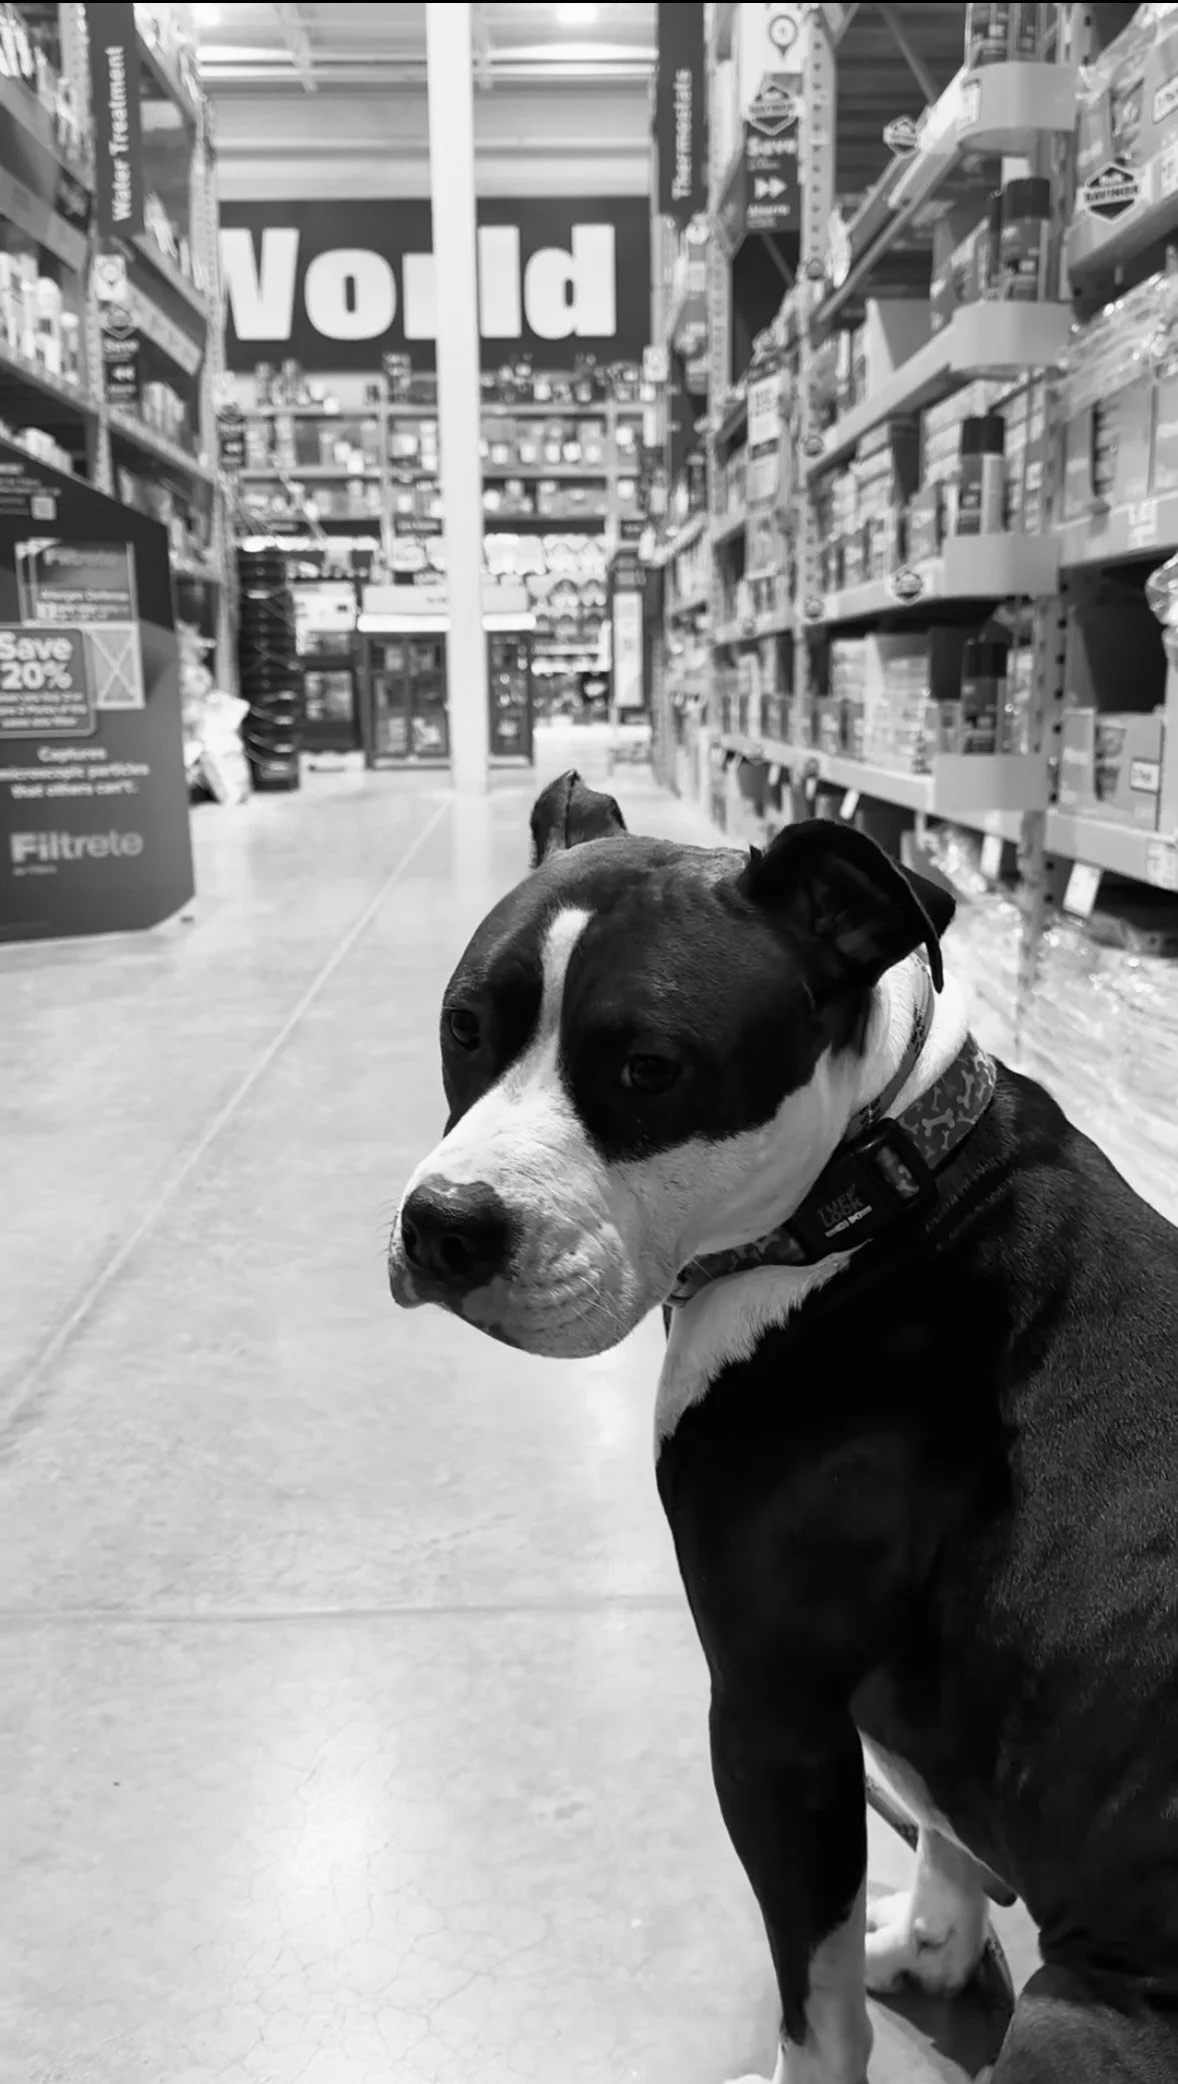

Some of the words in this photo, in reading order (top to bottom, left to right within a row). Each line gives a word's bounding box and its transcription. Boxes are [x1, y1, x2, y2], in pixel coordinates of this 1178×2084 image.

[105, 46, 130, 156] Treatment
[671, 68, 692, 202] Thermostats
[112, 157, 132, 221] Water
[0, 630, 73, 661] Save
[1, 661, 73, 690] 20%
[37, 744, 107, 763] Captures
[10, 829, 145, 863] Filtrete
